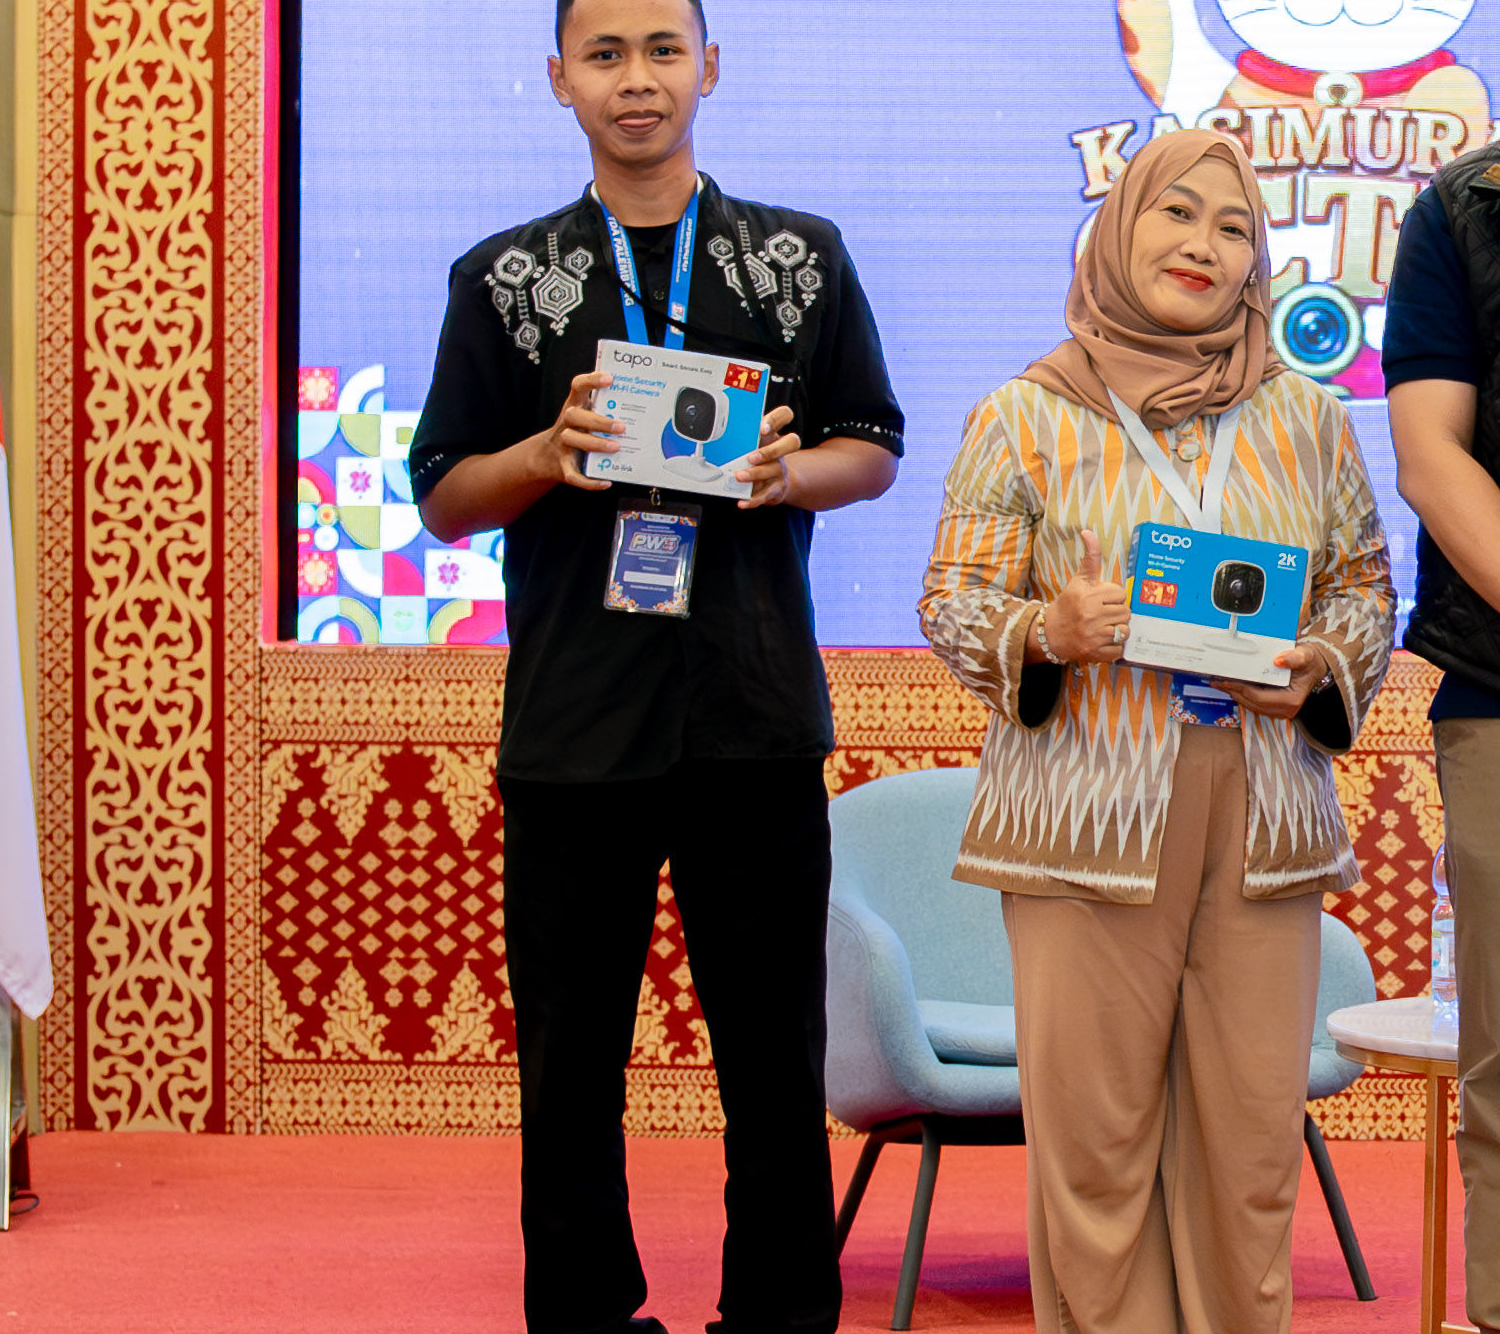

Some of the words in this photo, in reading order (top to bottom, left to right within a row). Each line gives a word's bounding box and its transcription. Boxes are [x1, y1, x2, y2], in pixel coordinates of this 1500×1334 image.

[614, 349, 652, 369] tapo
[1151, 530, 1192, 551] tapo
[1277, 553, 1297, 567] 2K
